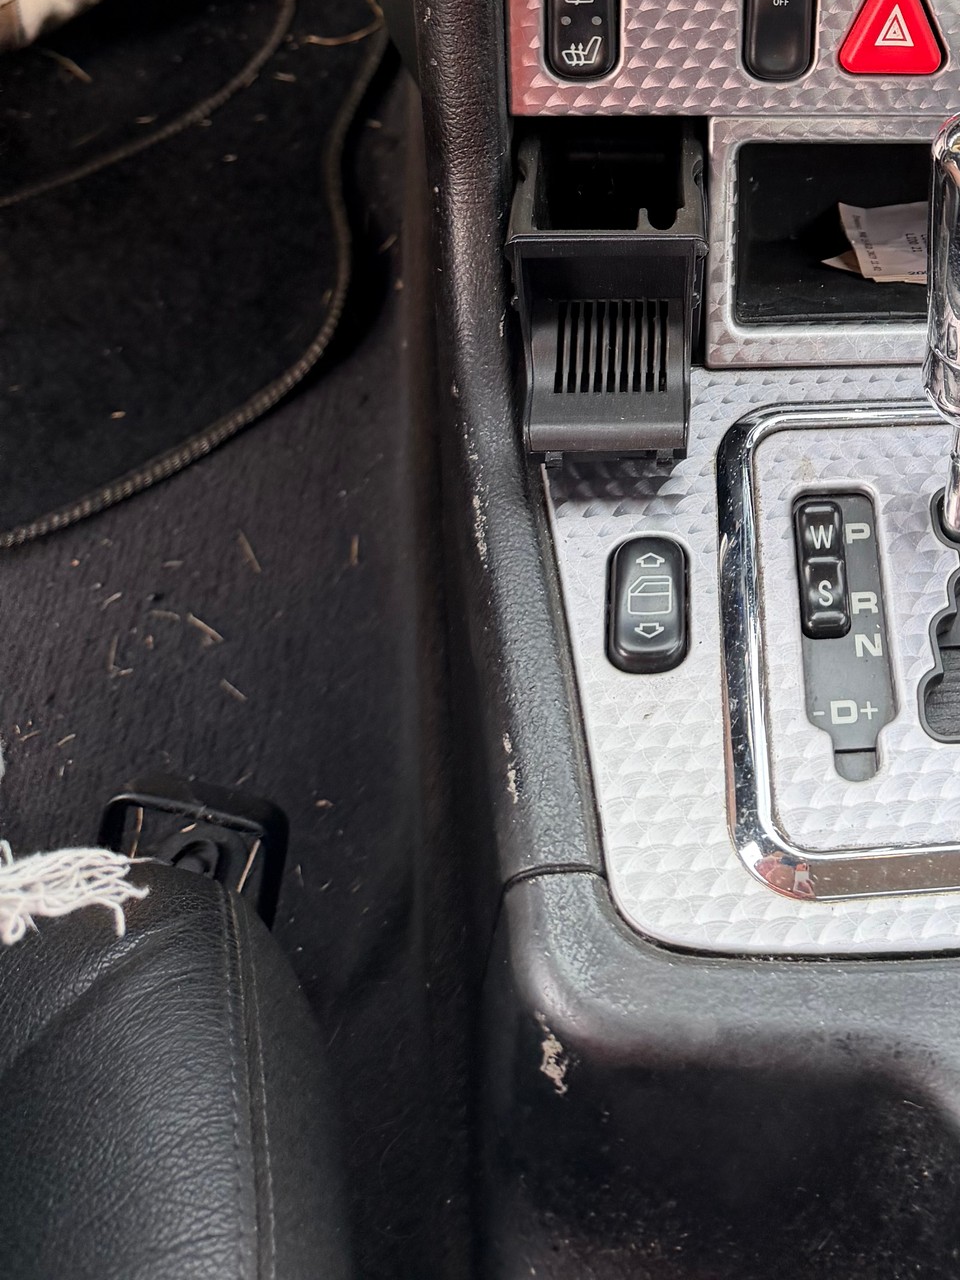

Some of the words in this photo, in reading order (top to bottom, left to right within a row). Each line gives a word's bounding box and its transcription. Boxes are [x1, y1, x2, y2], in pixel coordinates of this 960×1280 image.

[809, 523, 834, 550] W
[844, 522, 871, 544] P
[817, 579, 835, 607] S
[851, 591, 879, 615] R
[854, 633, 883, 658] N
